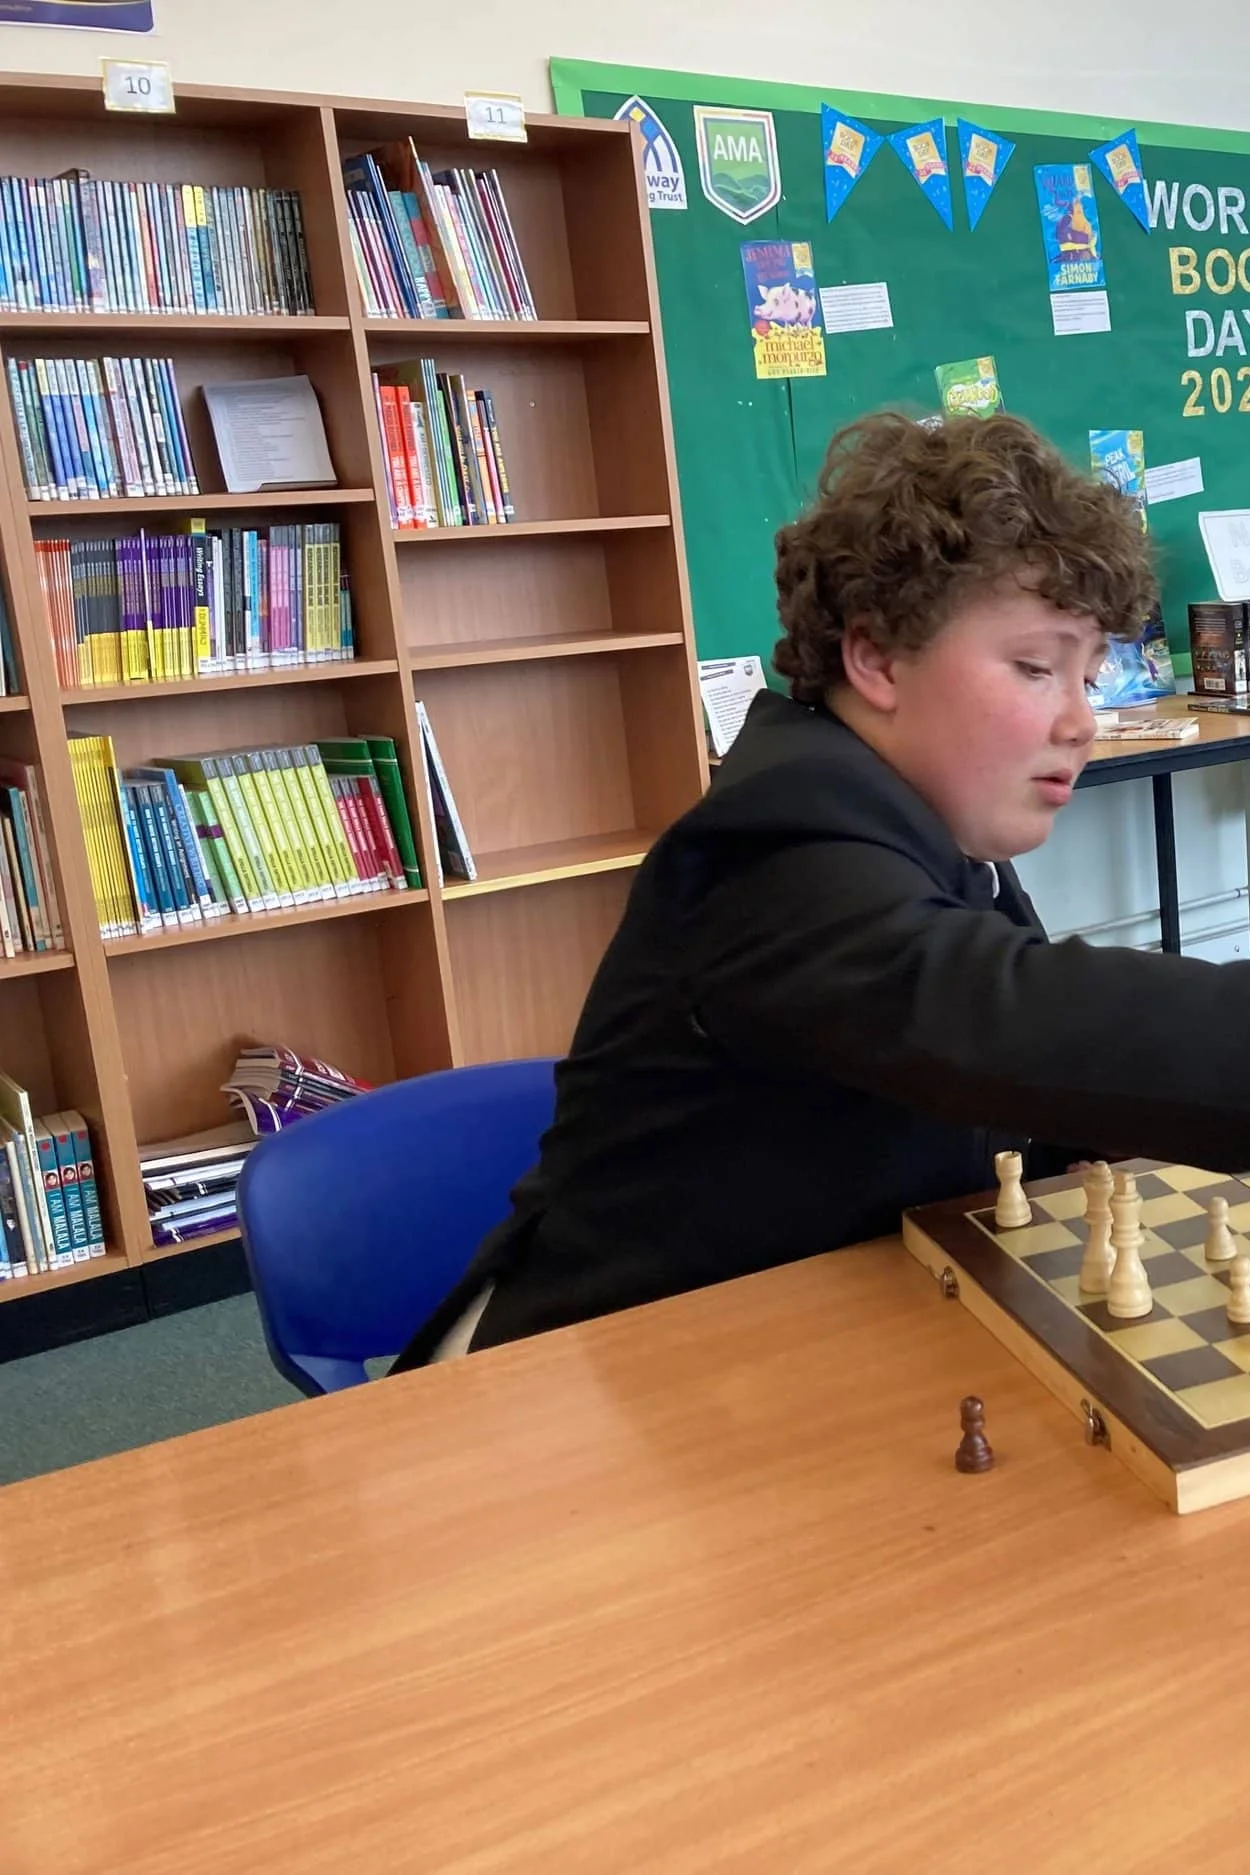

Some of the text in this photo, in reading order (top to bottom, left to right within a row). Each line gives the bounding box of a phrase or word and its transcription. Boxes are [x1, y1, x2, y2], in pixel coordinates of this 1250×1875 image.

[126, 76, 151, 96] 10
[486, 106, 507, 124] 11
[714, 133, 763, 163] AMA
[646, 175, 679, 192] way
[1061, 263, 1092, 274] SIMON
[1055, 272, 1099, 286] FARNABY
[765, 336, 814, 352] michael
[762, 351, 822, 367] morpurgo
[194, 547, 204, 572] Writing
[174, 802, 193, 847] CREATIVE
[66, 1192, 79, 1208] AM
[84, 1189, 95, 1204] AM
[49, 1198, 62, 1214] AM
[68, 1210, 86, 1243] MALALA
[85, 1205, 102, 1240] MALALA
[51, 1215, 69, 1249] MALALA
